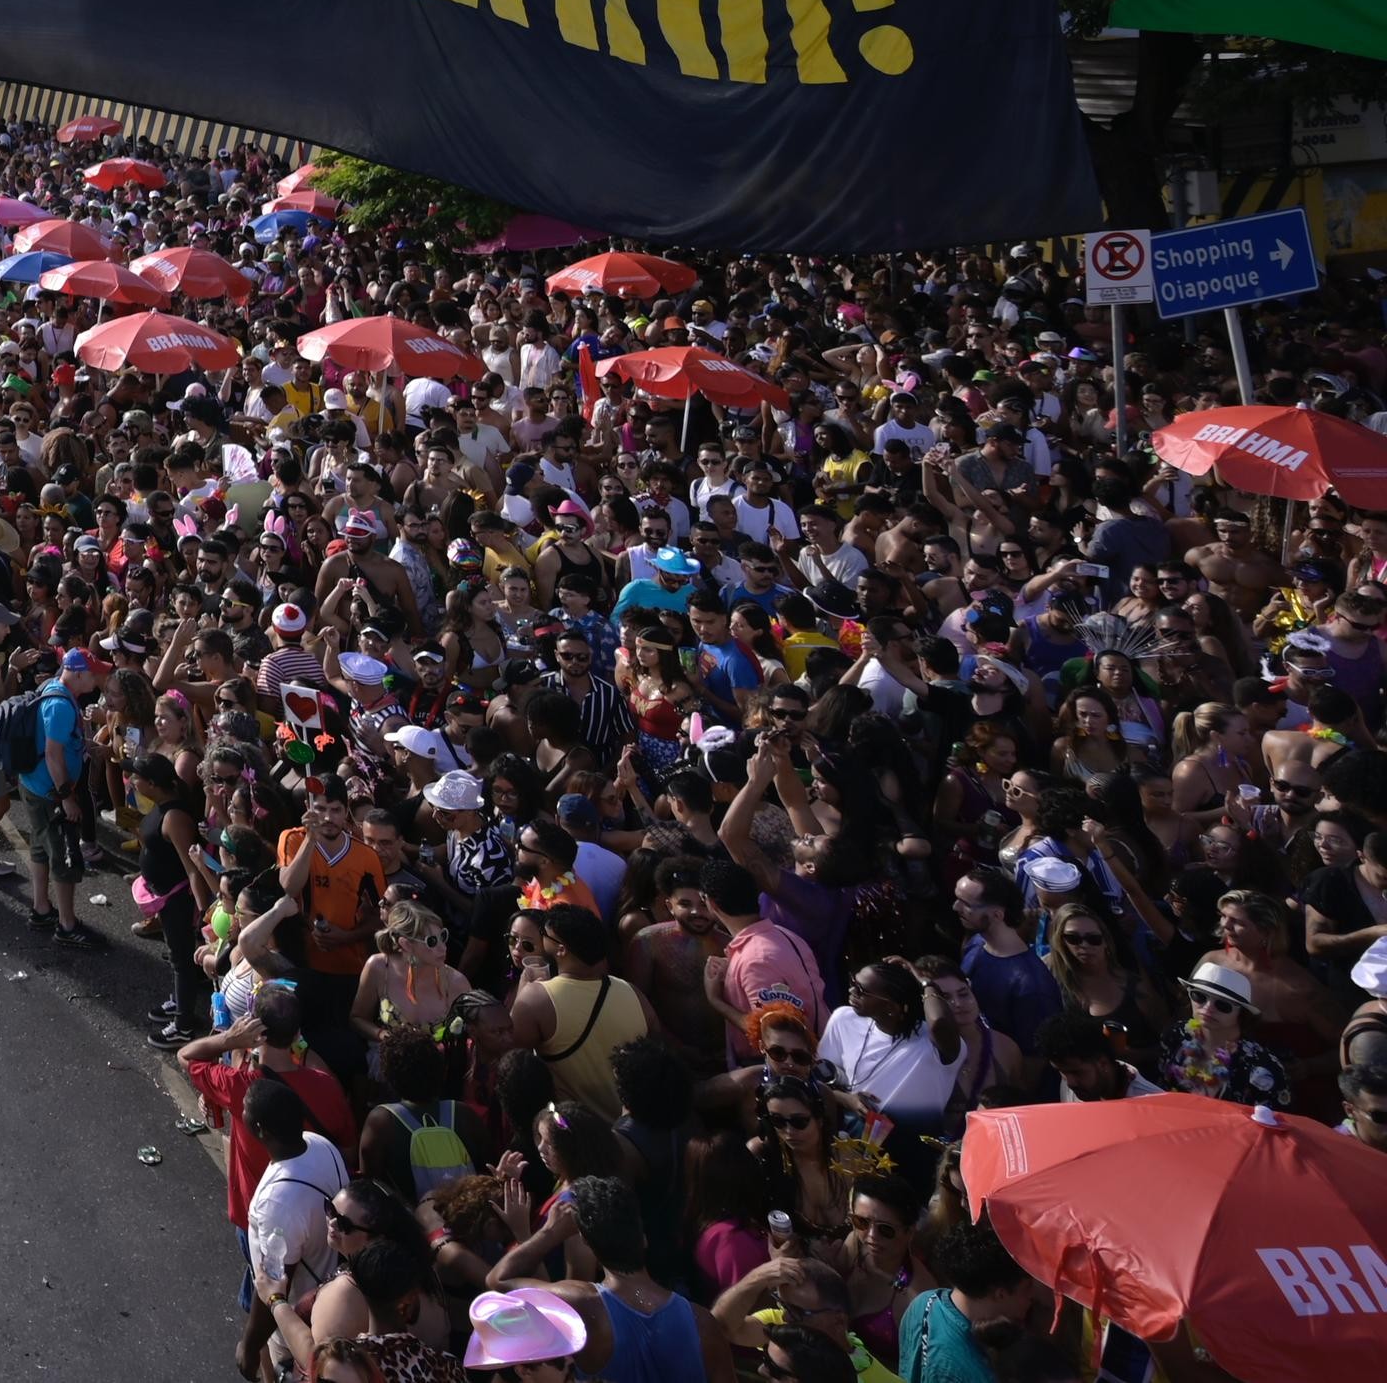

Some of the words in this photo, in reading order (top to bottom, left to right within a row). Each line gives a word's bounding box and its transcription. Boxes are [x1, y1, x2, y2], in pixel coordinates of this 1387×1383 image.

[1153, 238, 1254, 271] Shopping
[1160, 270, 1260, 302] Oiapoque
[147, 333, 218, 353] BRAHMA
[1193, 424, 1309, 472] BRAHMA
[315, 875, 330, 888] 52
